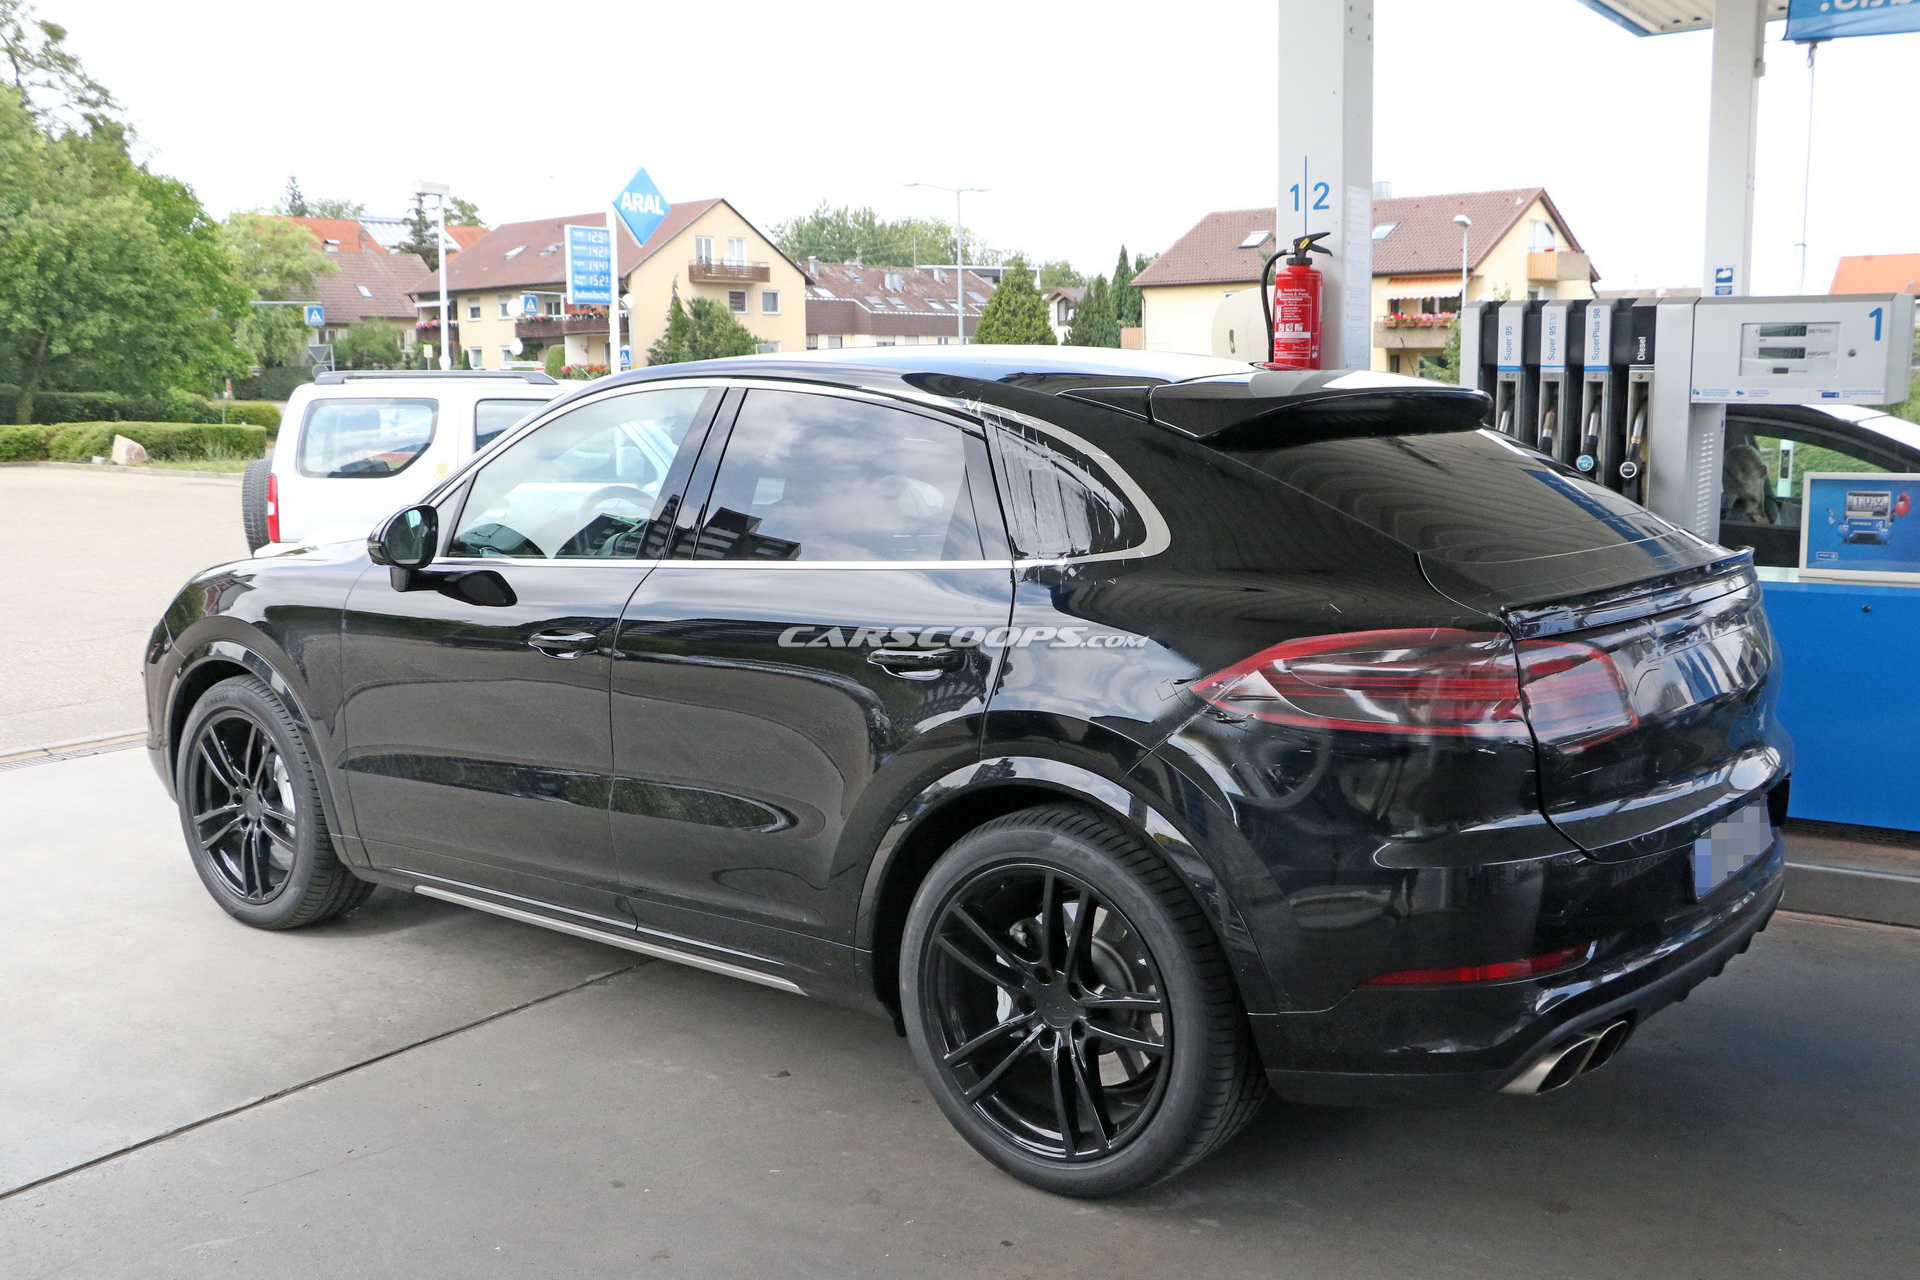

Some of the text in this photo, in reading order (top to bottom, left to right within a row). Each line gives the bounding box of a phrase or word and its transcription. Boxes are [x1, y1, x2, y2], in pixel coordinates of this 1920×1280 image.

[620, 192, 665, 215] ARAL
[1290, 182, 1330, 211] 1 2
[1593, 308, 1601, 319] 98
[1869, 307, 1883, 341] 1
[1504, 325, 1513, 361] Super 95
[1548, 338, 1557, 361] Super
[1592, 321, 1601, 361] SuperPlus
[1637, 336, 1646, 361] Diesel
